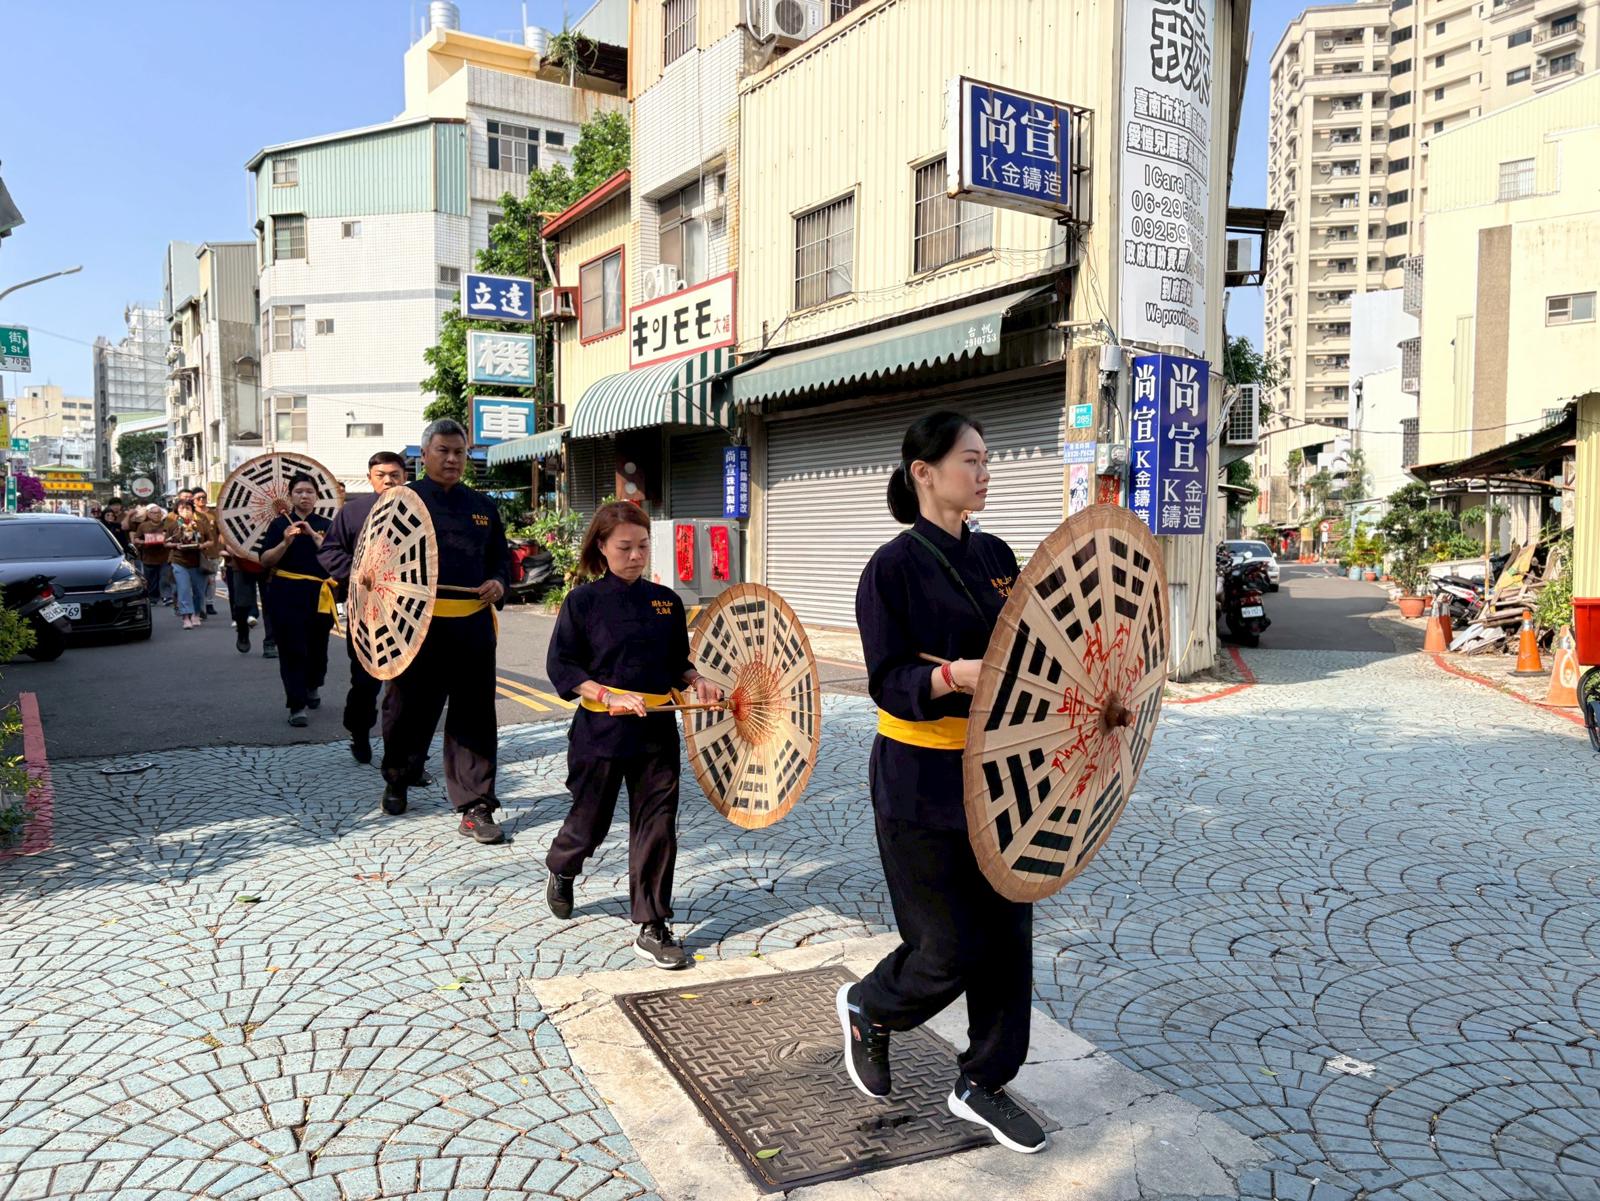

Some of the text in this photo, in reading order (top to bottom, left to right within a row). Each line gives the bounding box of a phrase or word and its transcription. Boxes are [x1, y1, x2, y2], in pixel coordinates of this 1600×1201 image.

[979, 97, 1060, 164] 尚宣
[980, 153, 1062, 198] K金鑄造
[470, 282, 529, 317] 立達
[1145, 302, 1162, 323] We
[8, 331, 22, 344] 街
[10, 345, 23, 354] St.
[478, 340, 530, 378] 機
[479, 403, 530, 440] 車
[1167, 362, 1201, 473] 尚宣
